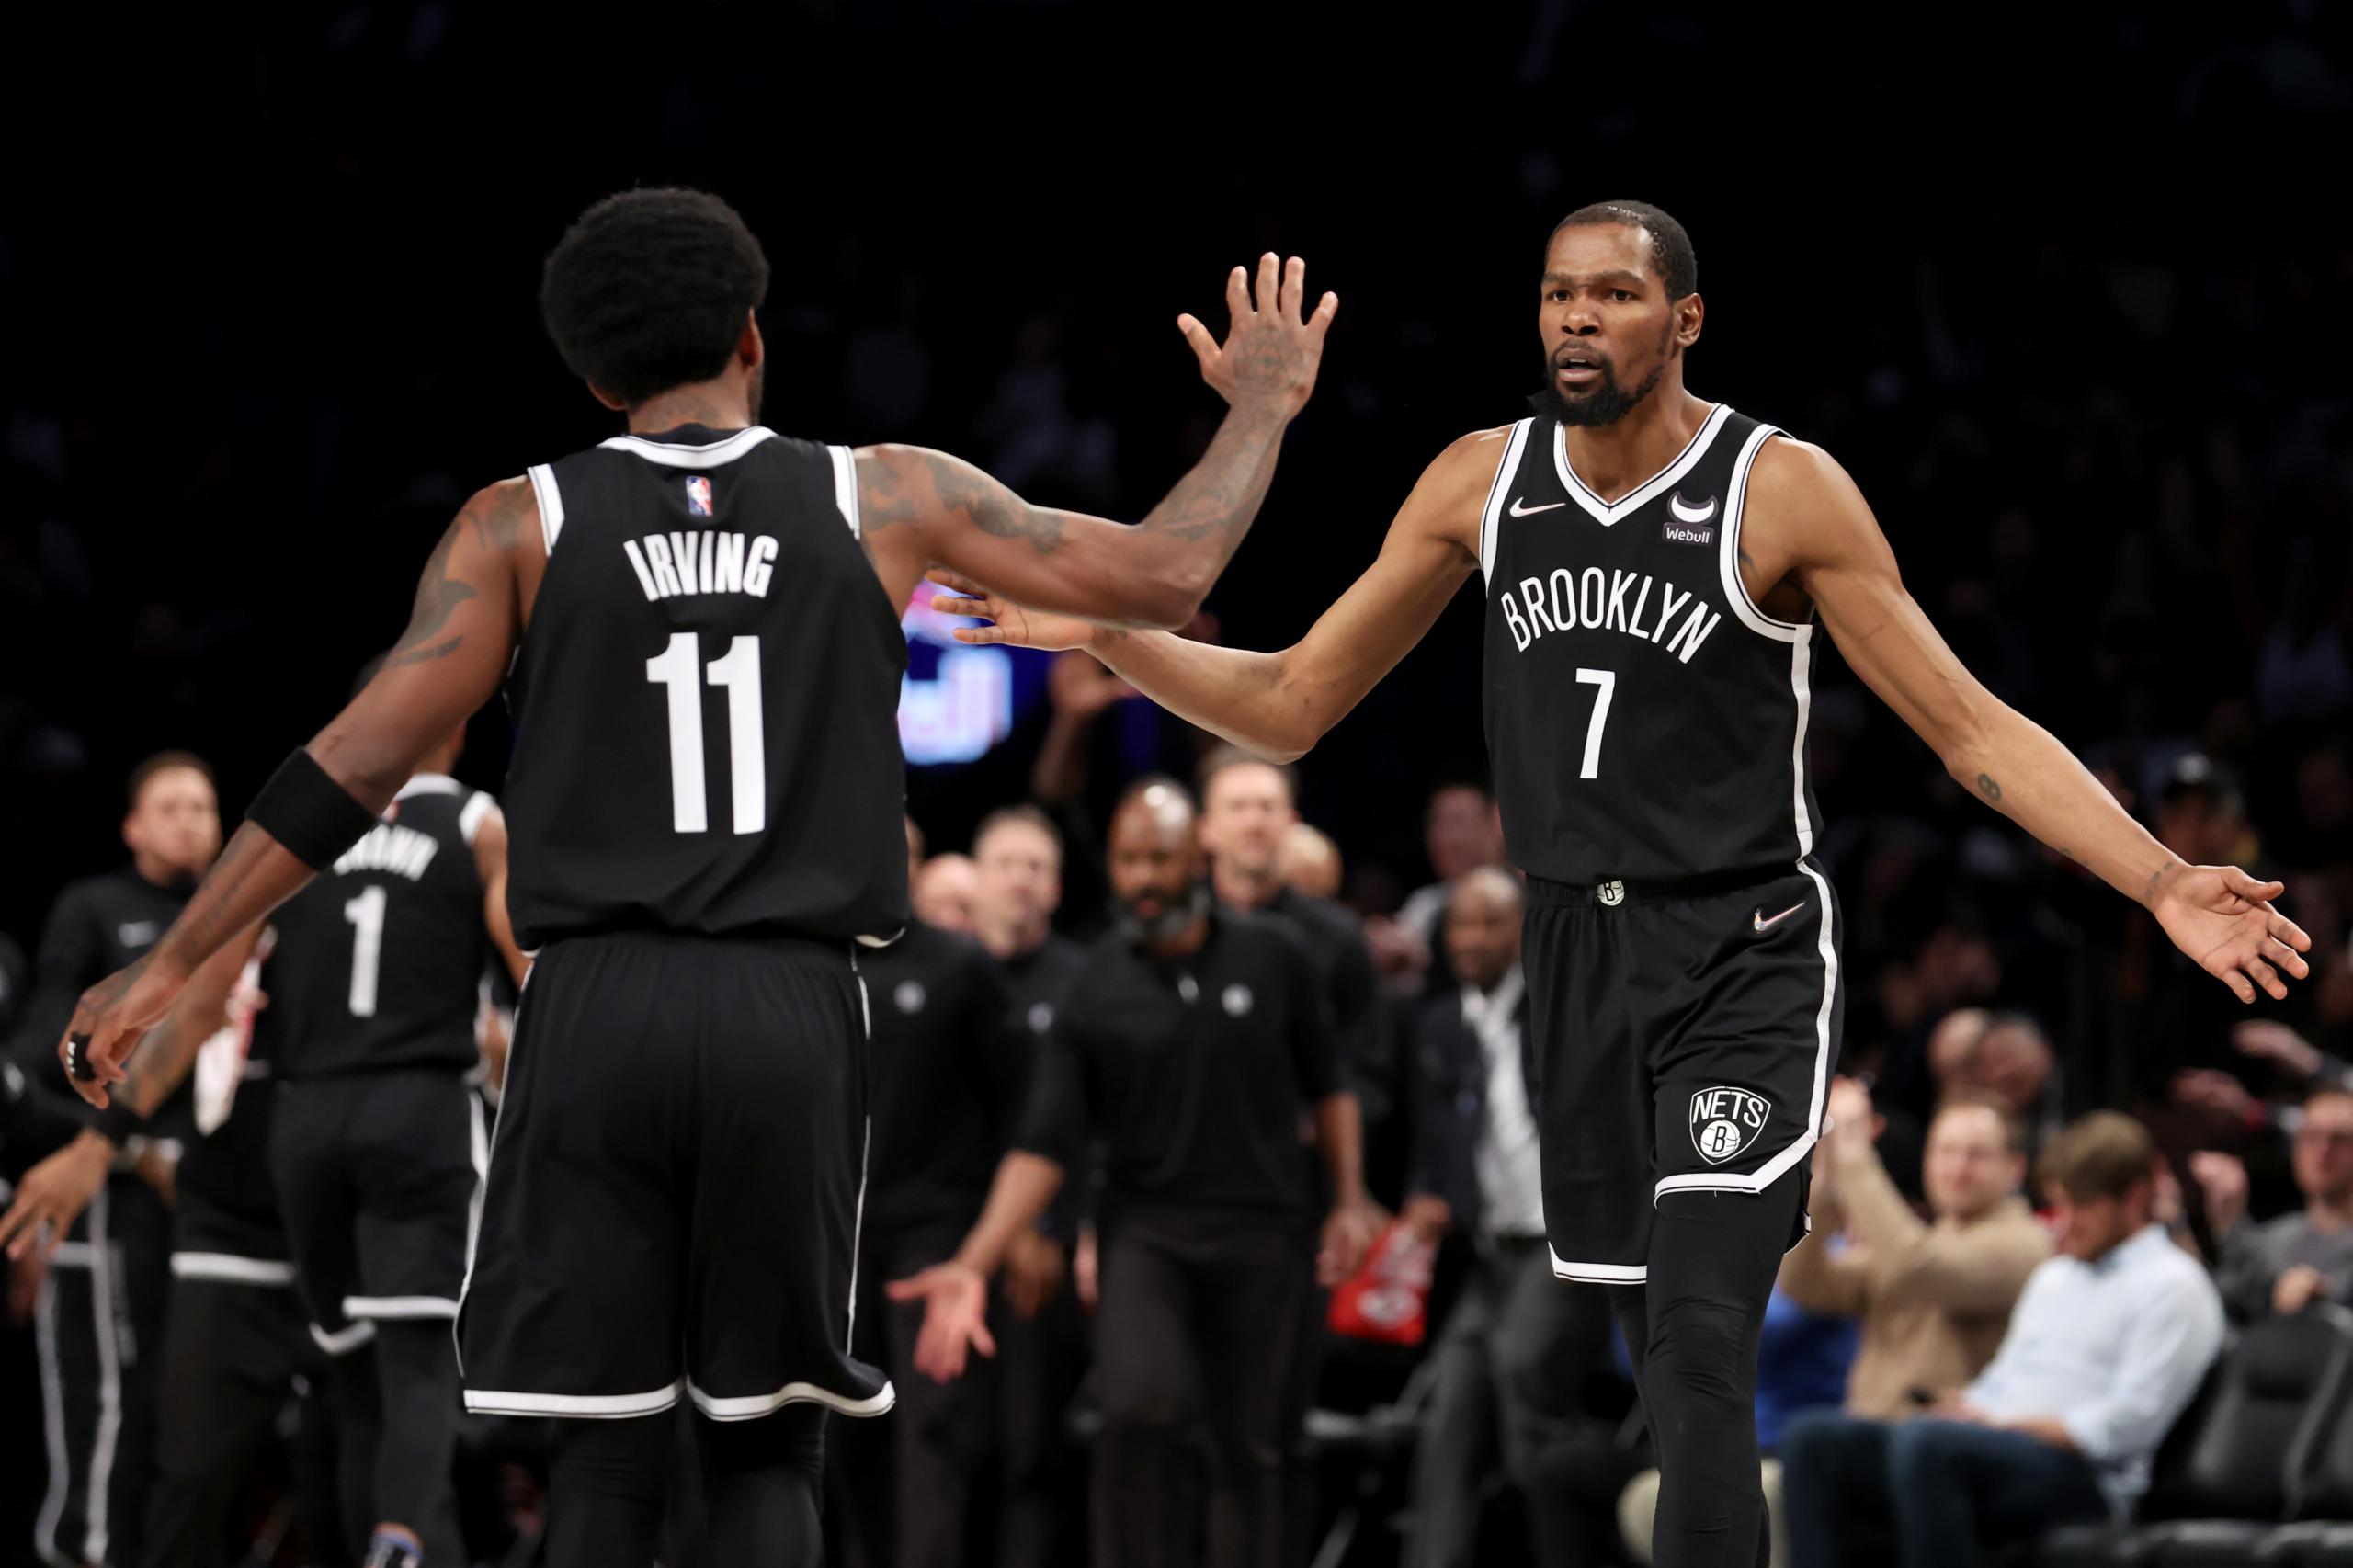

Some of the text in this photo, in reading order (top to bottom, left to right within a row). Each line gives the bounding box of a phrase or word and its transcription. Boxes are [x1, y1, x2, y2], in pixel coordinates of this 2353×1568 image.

[623, 530, 779, 601] IRVING
[1666, 527, 1710, 543] Webull
[1500, 567, 1722, 664] BROOKLYN
[646, 632, 766, 835] 11
[1575, 668, 1615, 779] 7
[345, 885, 386, 1017] 1
[1692, 1090, 1764, 1129] NETS
